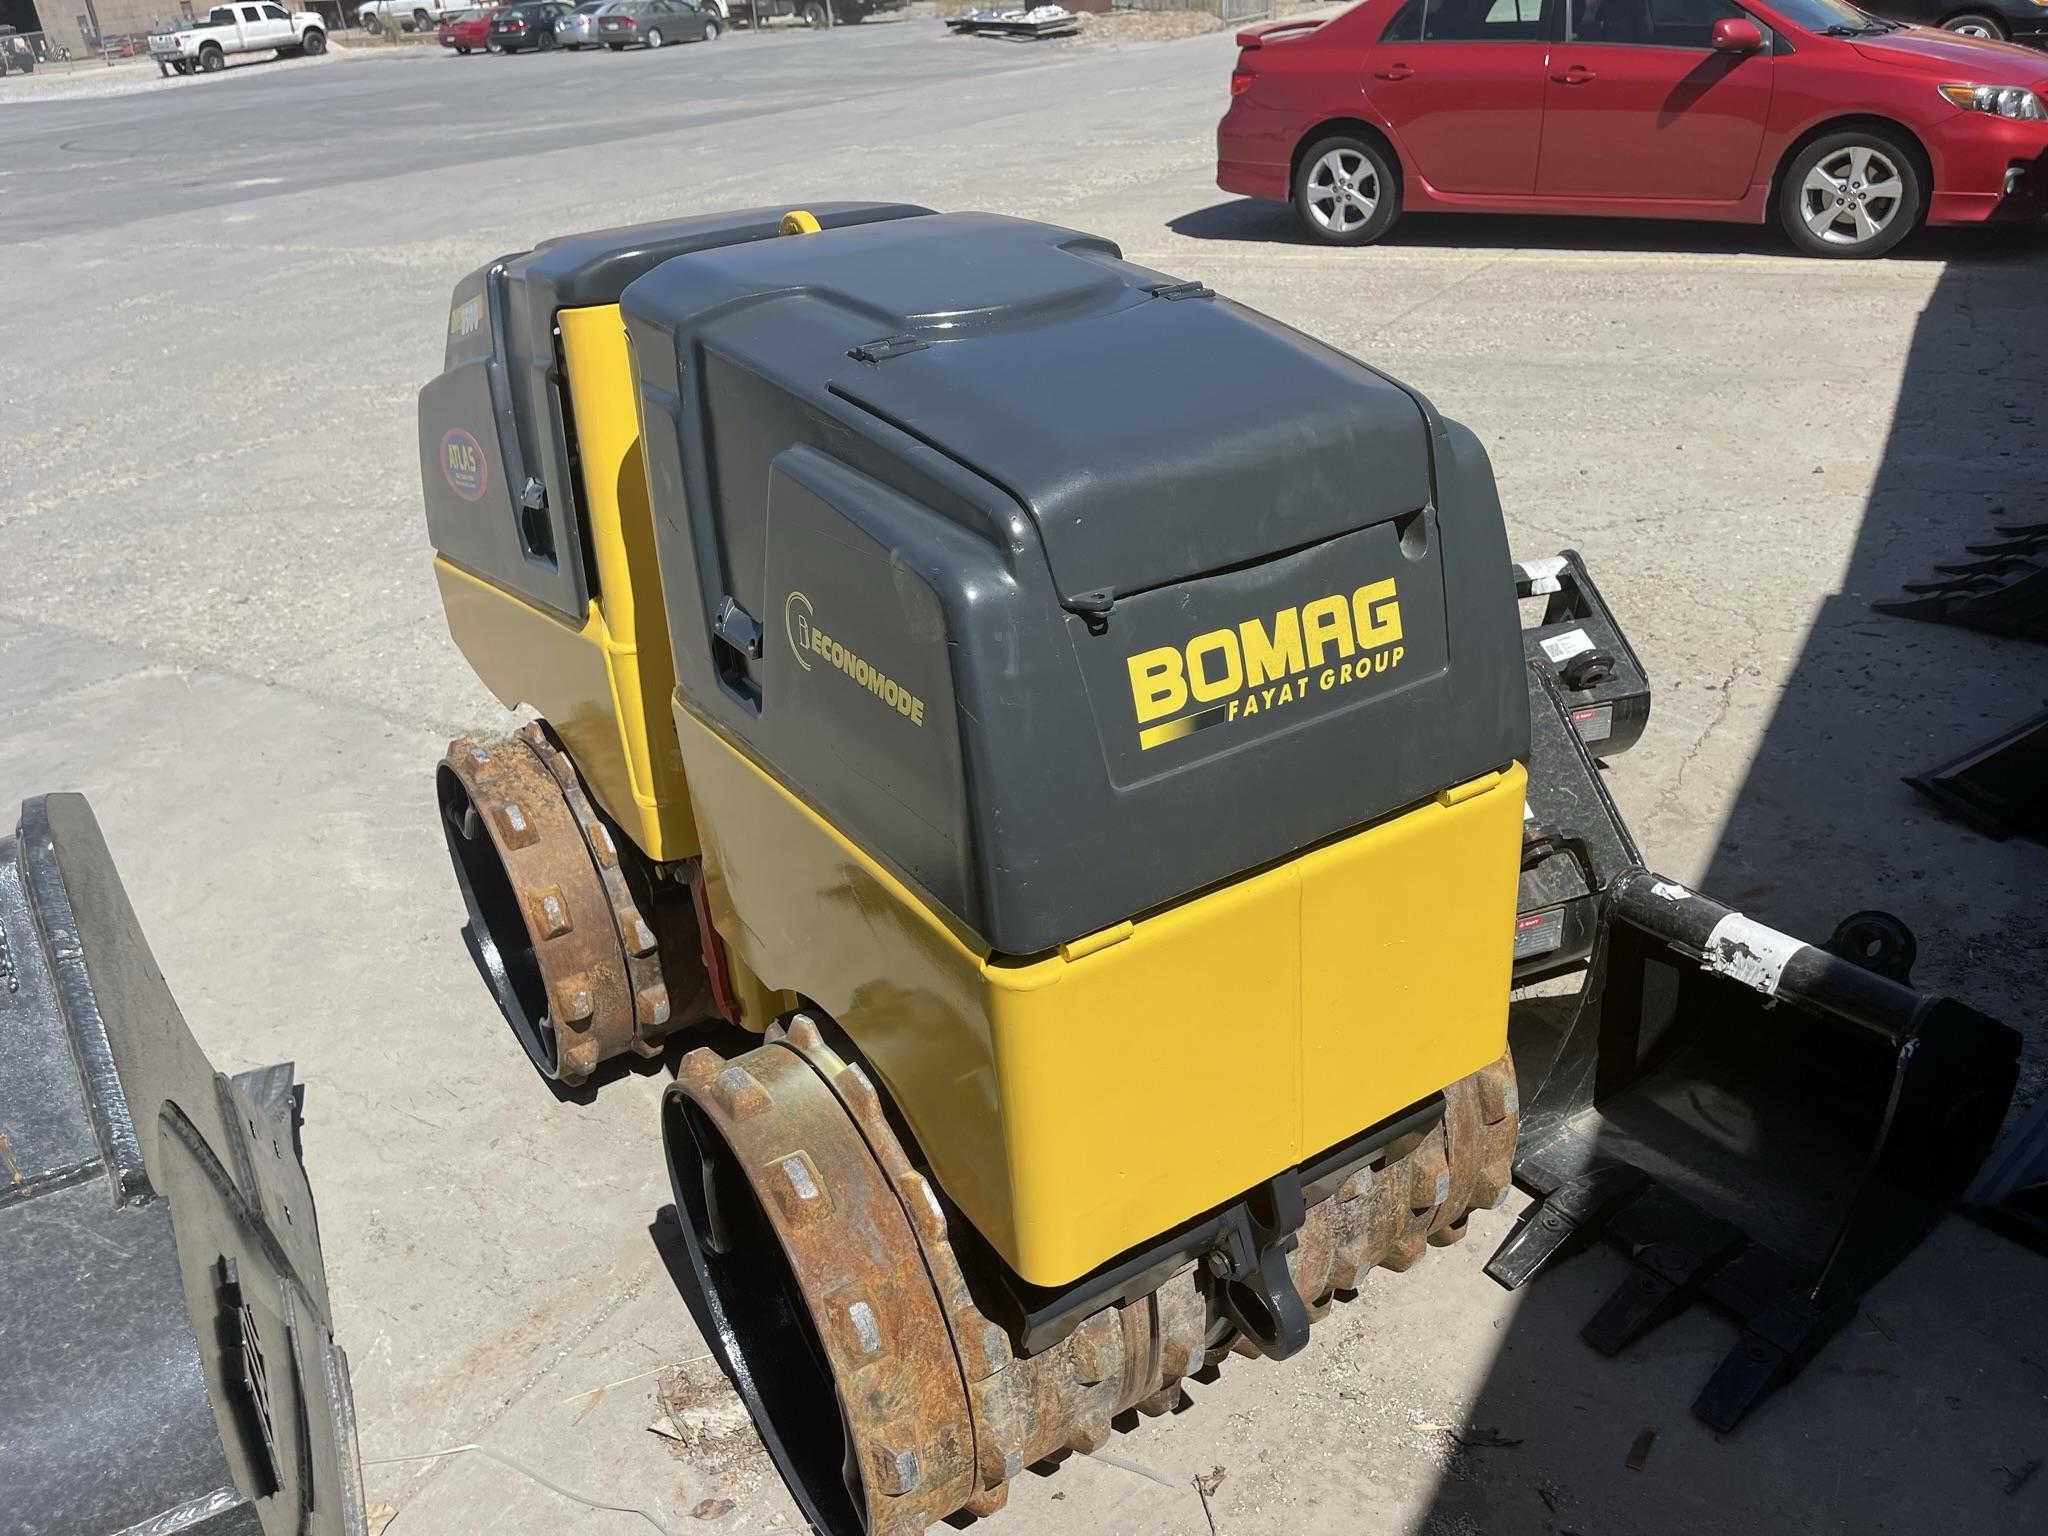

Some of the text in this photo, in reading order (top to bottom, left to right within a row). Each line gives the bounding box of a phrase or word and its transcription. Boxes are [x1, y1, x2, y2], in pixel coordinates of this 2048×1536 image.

[448, 443, 477, 472] ATLAS
[811, 627, 924, 727] ECONOMODE
[1127, 577, 1403, 724] BOMAG
[1228, 646, 1404, 722] FAYAT GROUP
